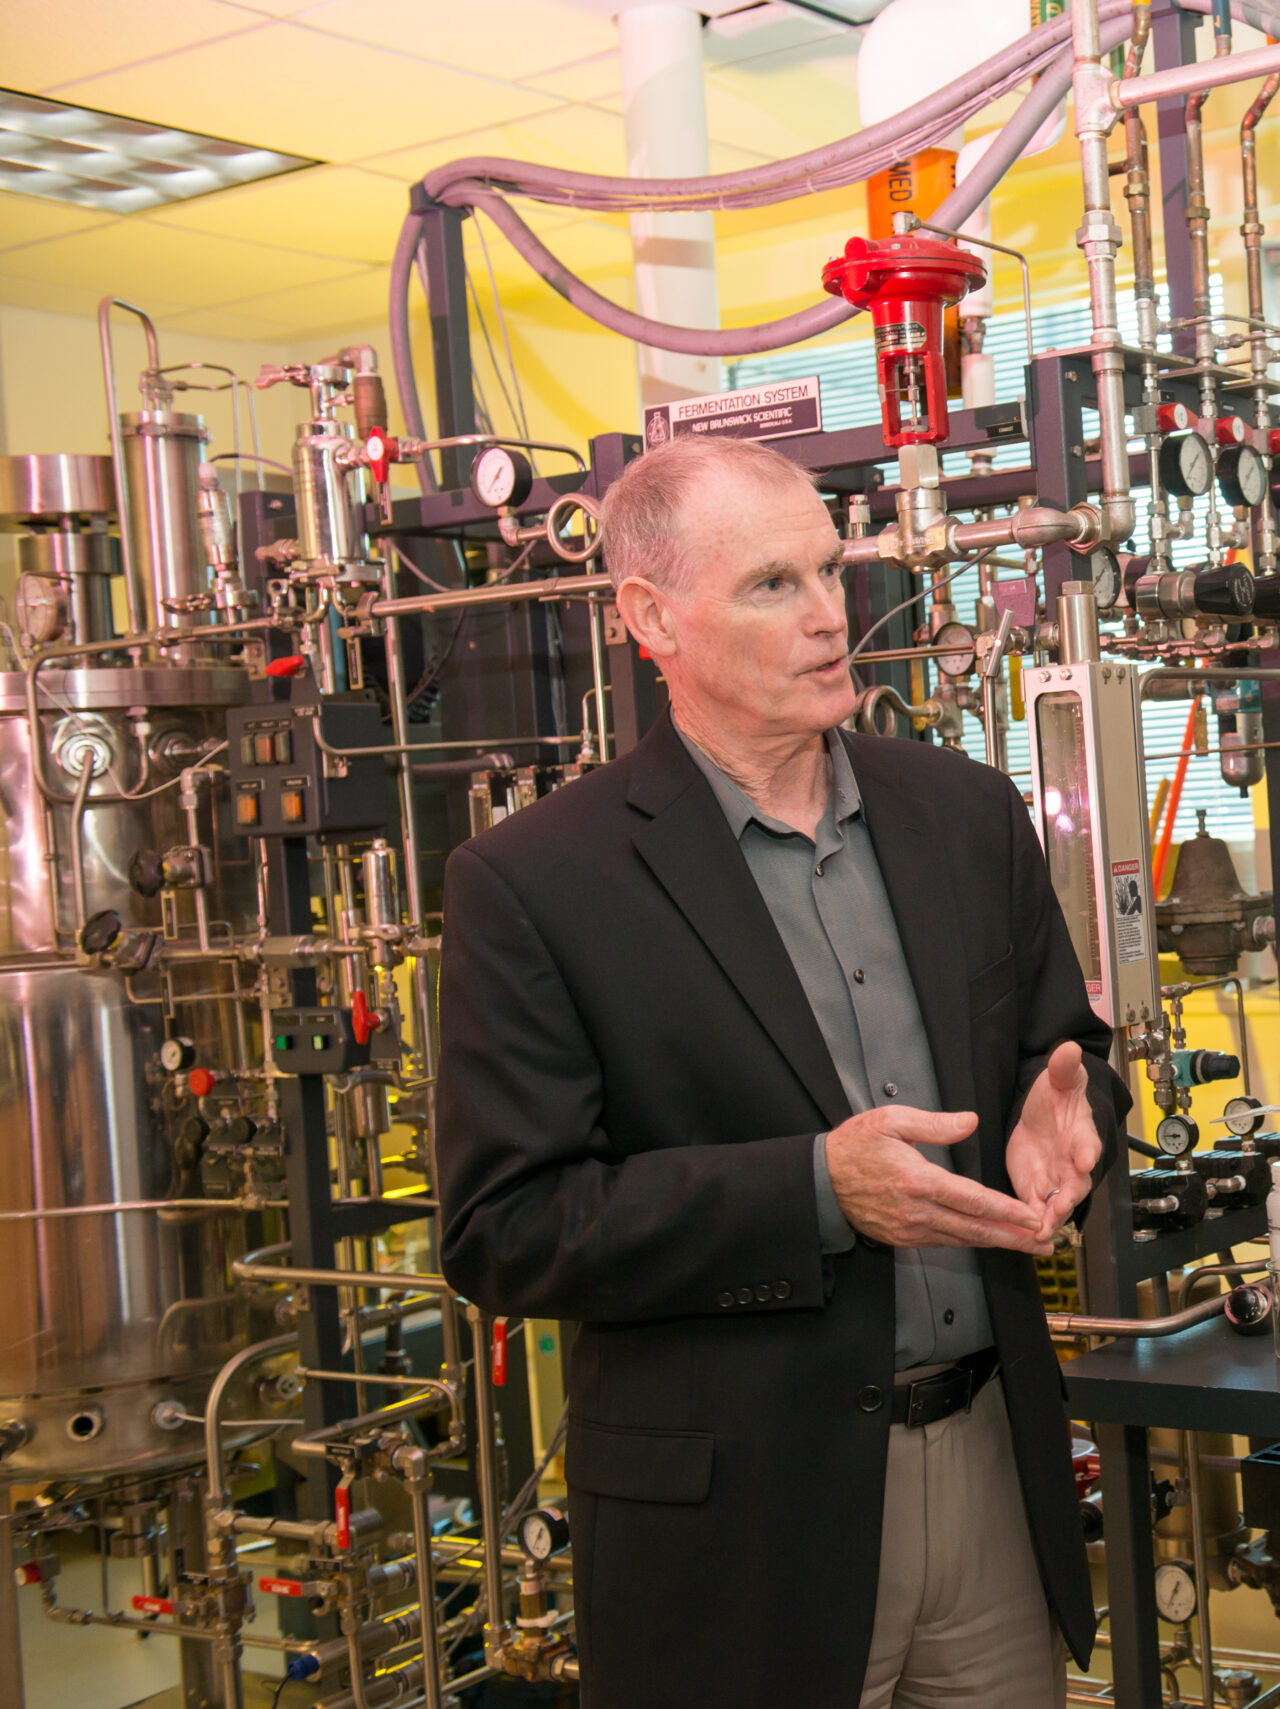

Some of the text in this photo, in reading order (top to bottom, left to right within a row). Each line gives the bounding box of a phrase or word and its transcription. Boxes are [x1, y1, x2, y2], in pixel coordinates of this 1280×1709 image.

[678, 384, 809, 419] FERMENTATION SYSTEM
[691, 421, 709, 433] NEW
[709, 413, 753, 431] BRUNSWICK
[752, 406, 793, 423] SCIENTIFIC
[1117, 862, 1139, 873] DANGER
[1086, 983, 1101, 994] GER
